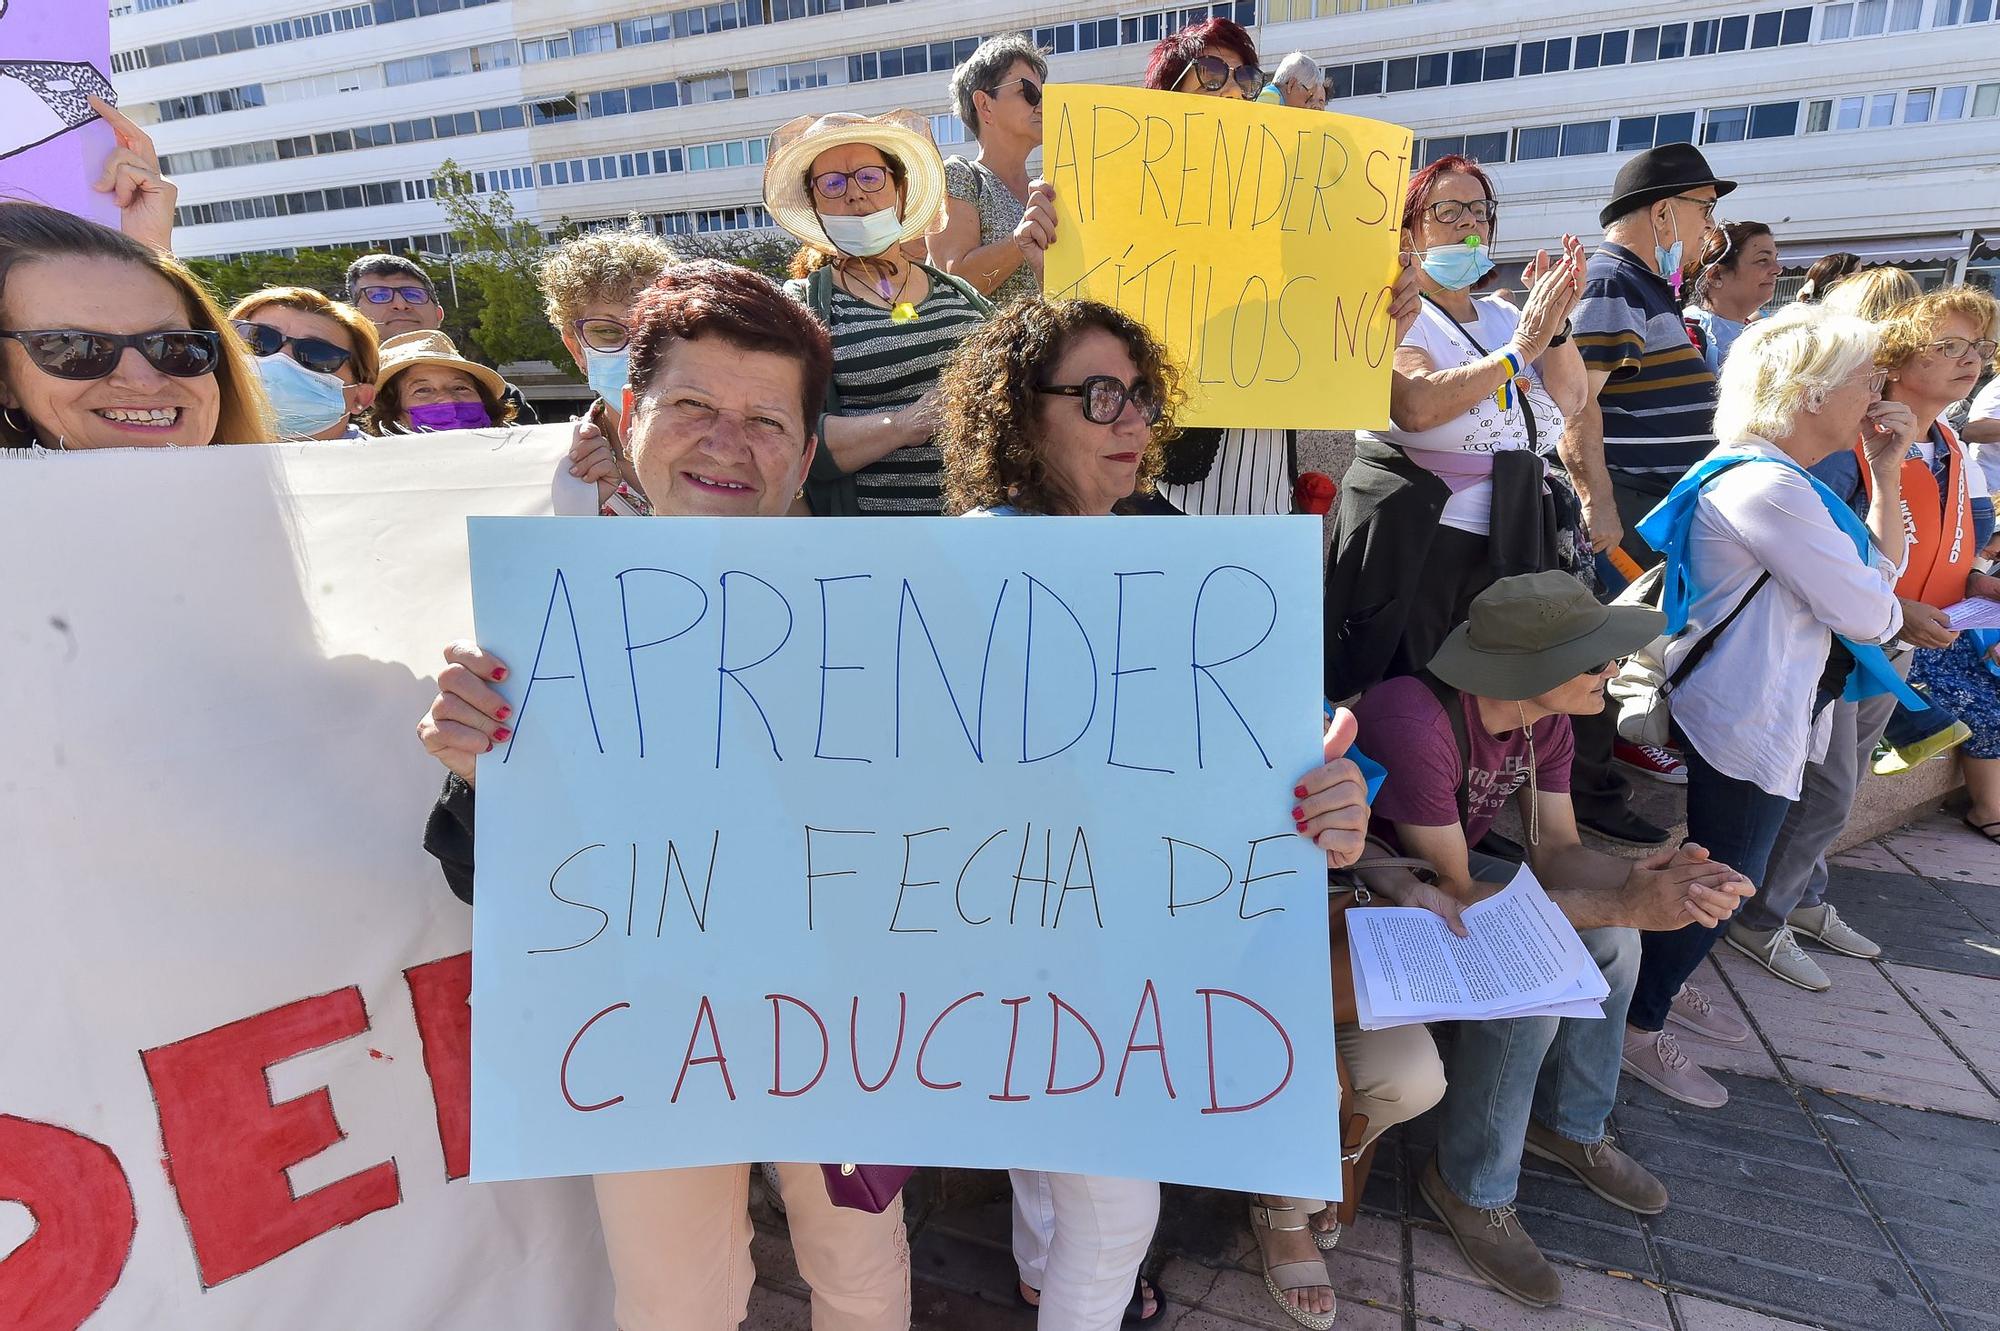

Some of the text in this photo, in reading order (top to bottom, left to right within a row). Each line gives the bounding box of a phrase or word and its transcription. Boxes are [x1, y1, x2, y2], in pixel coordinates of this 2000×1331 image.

[1053, 103, 1409, 235] APRENDER SÍ
[1333, 286, 1394, 369] NO
[504, 566, 1277, 774] APRENDER
[528, 823, 1299, 954] SIN FECHA DE
[560, 979, 1294, 1113] CADUCIDAD
